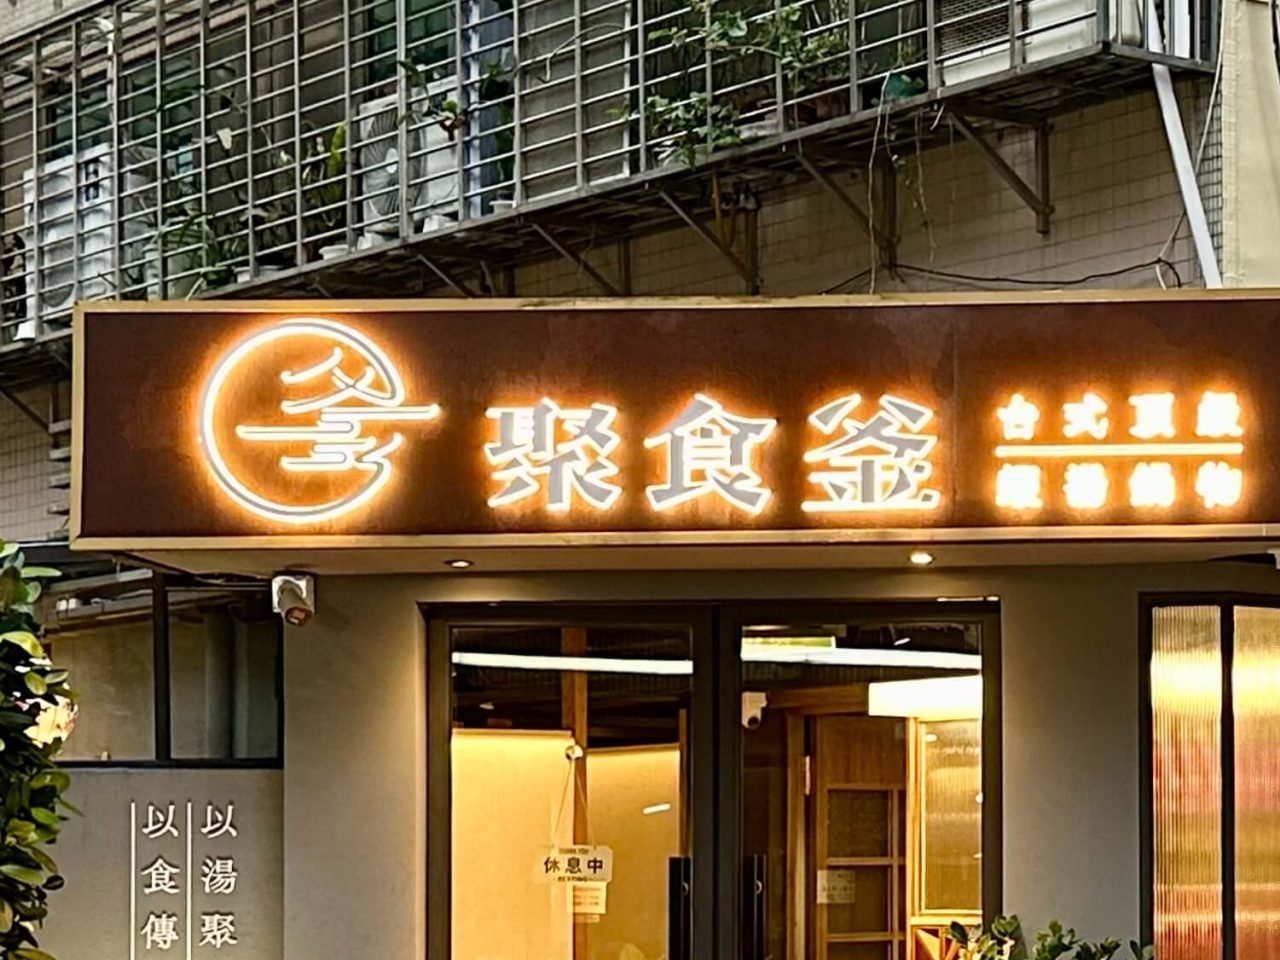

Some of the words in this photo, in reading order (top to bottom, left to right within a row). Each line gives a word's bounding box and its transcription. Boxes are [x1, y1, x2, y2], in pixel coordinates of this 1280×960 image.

[484, 396, 943, 515] 聚食釜
[543, 856, 604, 874] 休息中
